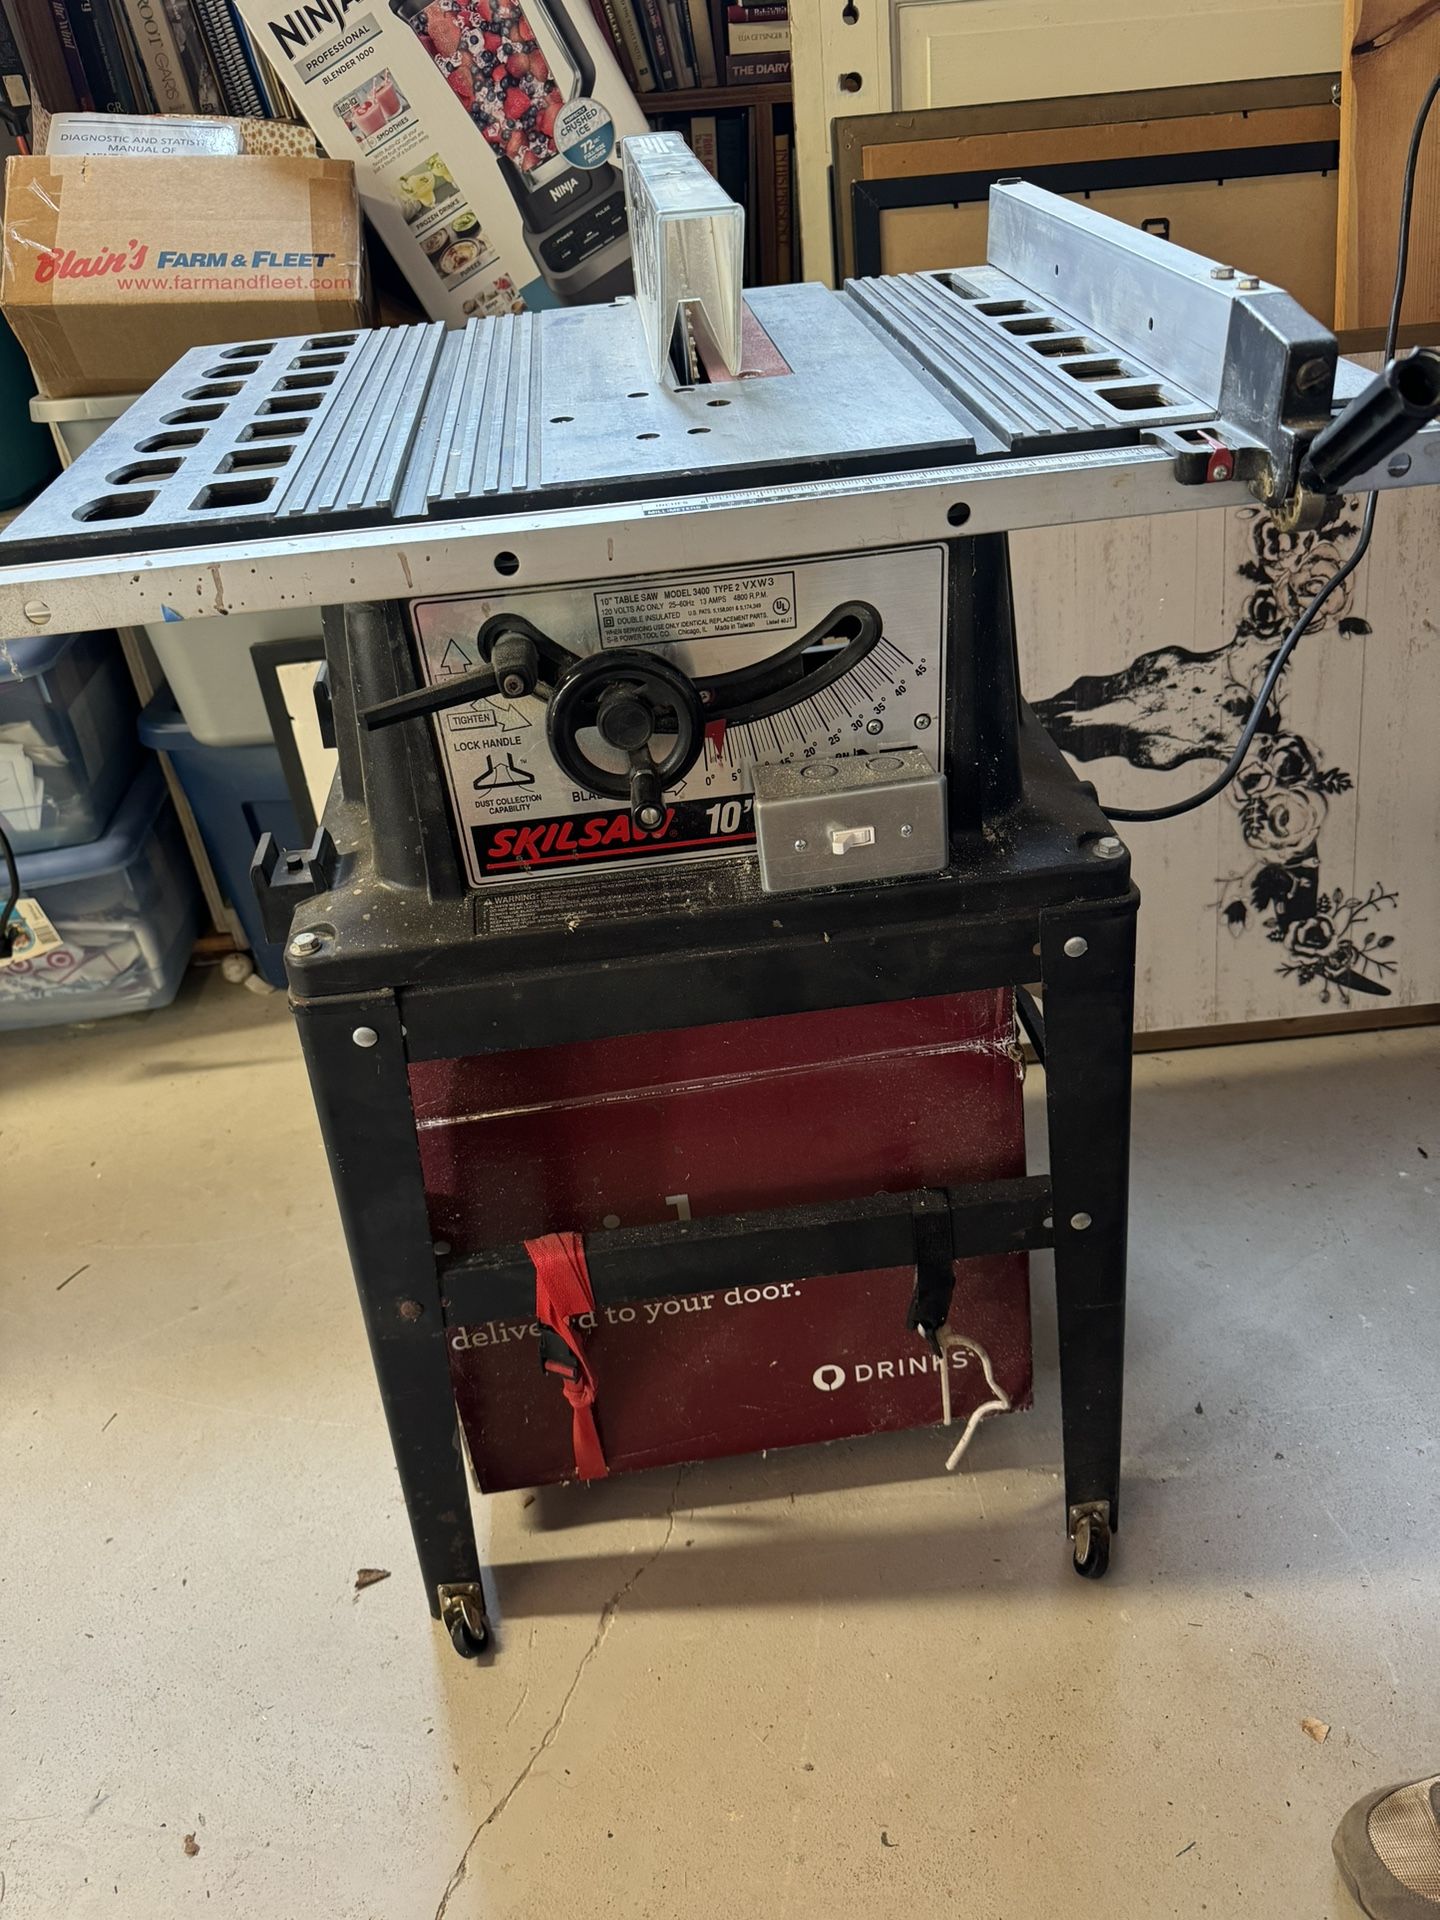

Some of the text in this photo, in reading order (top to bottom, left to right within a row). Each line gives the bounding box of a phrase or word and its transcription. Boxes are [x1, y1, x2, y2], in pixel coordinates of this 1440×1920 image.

[305, 25, 370, 72] PROFESSIONAL
[322, 46, 375, 85] BLENDER 1000
[732, 62, 789, 76] THE DIARY
[376, 116, 410, 142] SMOOTHIES
[559, 108, 599, 137] CRUSHED
[575, 123, 591, 137] ICE
[60, 133, 130, 146] DIAGNOSTIC
[132, 135, 158, 146] AND
[579, 138, 596, 154] 72
[108, 144, 159, 154] MANUAL
[162, 146, 177, 154] OF
[549, 178, 578, 202] NINJA
[416, 198, 460, 230] FROZEN DRINKS
[33, 239, 333, 283] Blain's FARM & FLEET
[117, 274, 352, 290] www.farmandfleet.com
[614, 594, 639, 604] TABLE
[640, 592, 658, 601] SAW
[664, 588, 692, 599] MODEL
[693, 587, 710, 596] 3400
[713, 584, 734, 593] TYPE
[742, 577, 775, 590] VXW3
[614, 606, 634, 614] VOLTS
[636, 604, 646, 612] AC
[646, 603, 664, 611] ONLY
[708, 596, 727, 604] AMPS
[733, 593, 748, 601] 4800
[749, 591, 768, 600] R.P.M.
[617, 616, 644, 625] DOUBLE
[645, 612, 681, 622] INSULATED
[680, 619, 708, 627] IDENTICAL
[709, 614, 749, 624] REPLACEMENT
[620, 633, 642, 642] POWER
[643, 631, 659, 639] TOOL
[678, 627, 702, 636] Chicago,
[737, 620, 755, 628] Taiwan
[914, 658, 926, 678] 45°
[894, 680, 906, 698] 40°
[873, 696, 886, 715] 35°
[452, 713, 490, 726] TIGHTEN
[850, 714, 865, 732] 30°
[454, 736, 522, 752] LOCK HANDLE
[828, 728, 842, 745] 25°
[804, 742, 818, 758] 20°
[705, 774, 716, 786] 0°
[732, 768, 742, 782] 5°
[475, 794, 542, 809] DUST COLLECTION
[489, 804, 531, 814] CAPABILITY
[495, 892, 540, 904] WARNING:
[452, 1282, 802, 1350] delived to your door.
